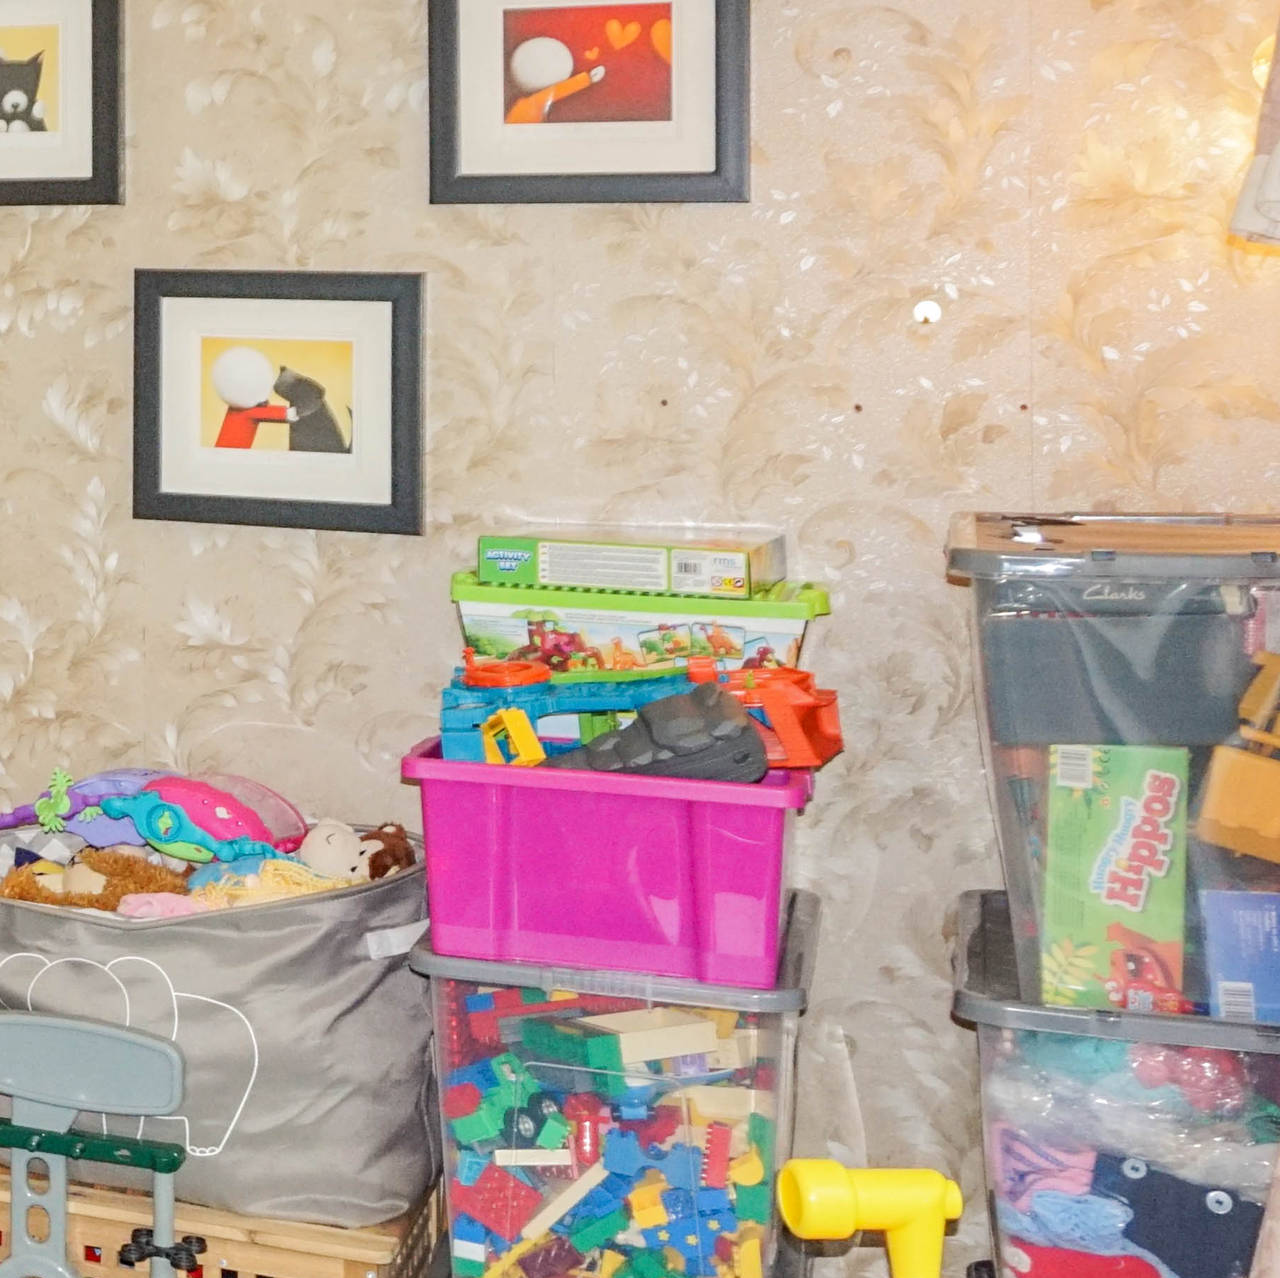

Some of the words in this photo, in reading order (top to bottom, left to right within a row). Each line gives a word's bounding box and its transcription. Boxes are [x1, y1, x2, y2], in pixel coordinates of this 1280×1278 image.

[485, 550, 532, 561] ACTIVITY
[1083, 584, 1146, 600] Clarks
[1104, 772, 1178, 908] Hippos
